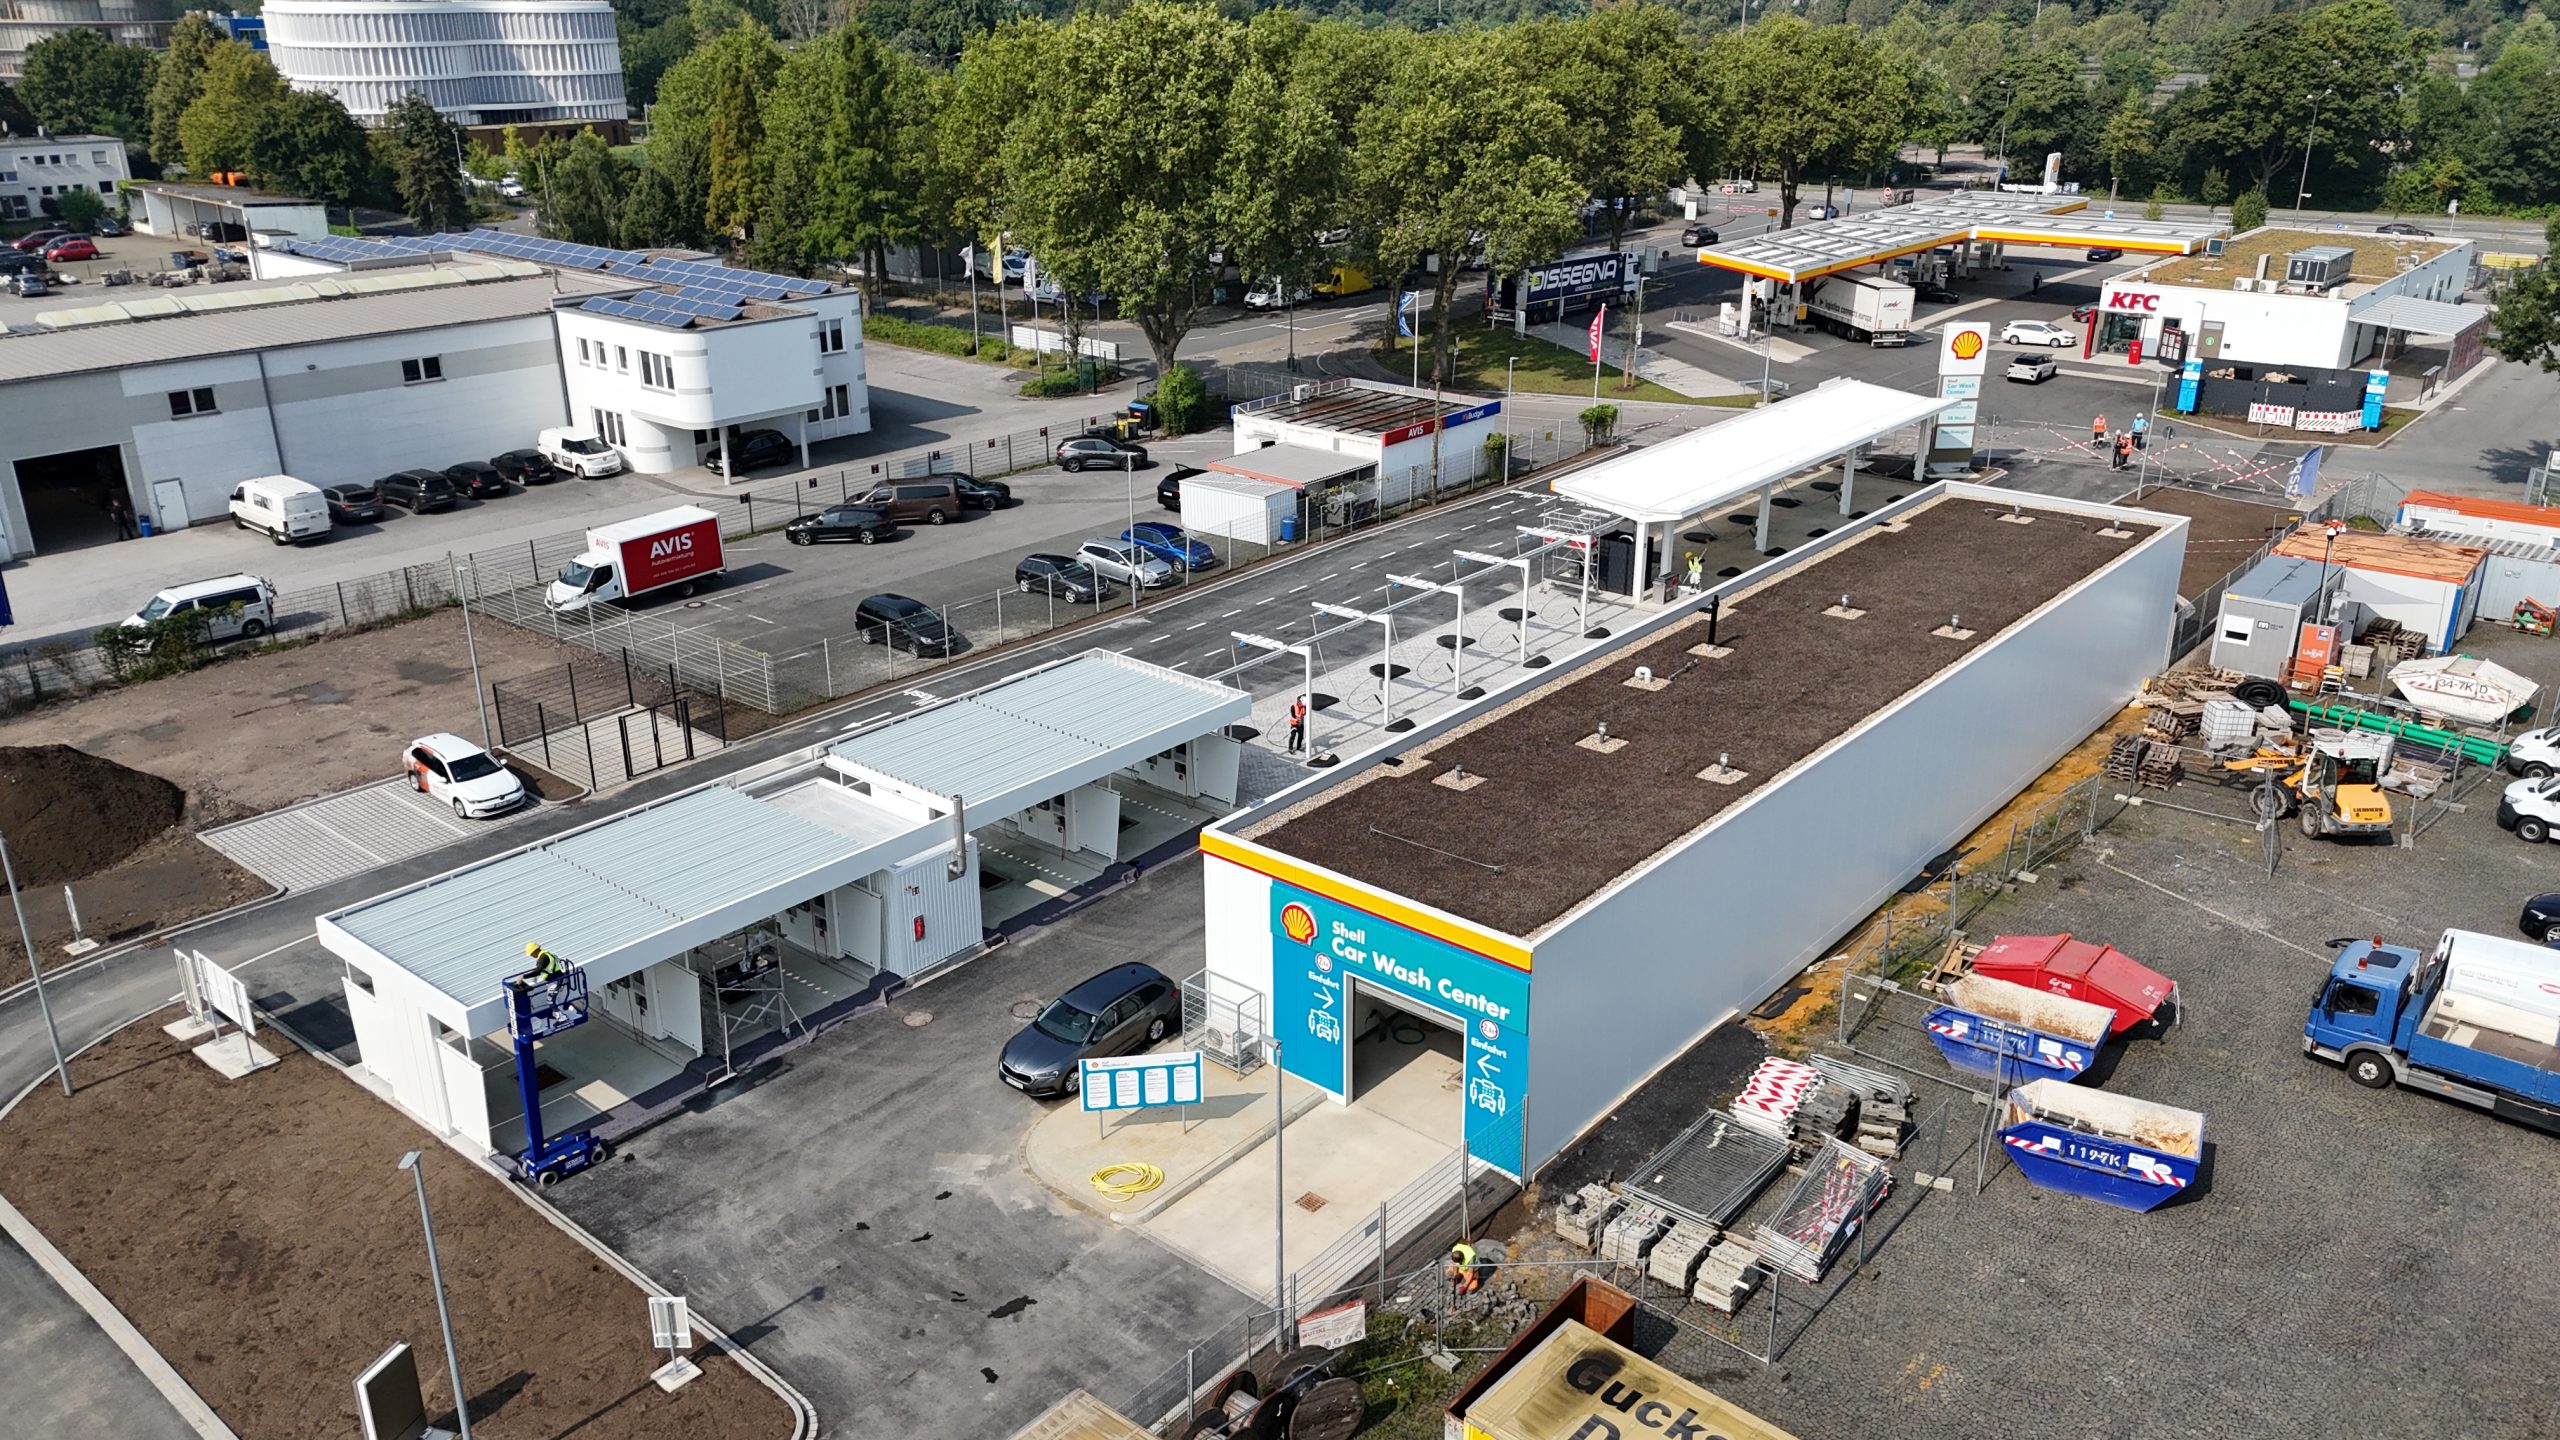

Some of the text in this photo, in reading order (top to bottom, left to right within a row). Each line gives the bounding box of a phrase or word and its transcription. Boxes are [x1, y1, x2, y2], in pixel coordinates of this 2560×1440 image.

[1530, 260, 1618, 293] DISSEGNA
[2108, 291, 2160, 311] KFC
[1407, 425, 1424, 438] AVIS
[595, 538, 610, 550] AVIS
[650, 532, 693, 559] AVIS
[1332, 920, 1366, 945] Shell
[1308, 970, 1340, 990] Einfahrt
[1331, 936, 1510, 1021] Car Wash Center
[1471, 1036, 1508, 1059] Einfahrt
[1566, 1357, 1729, 1440] Guck
